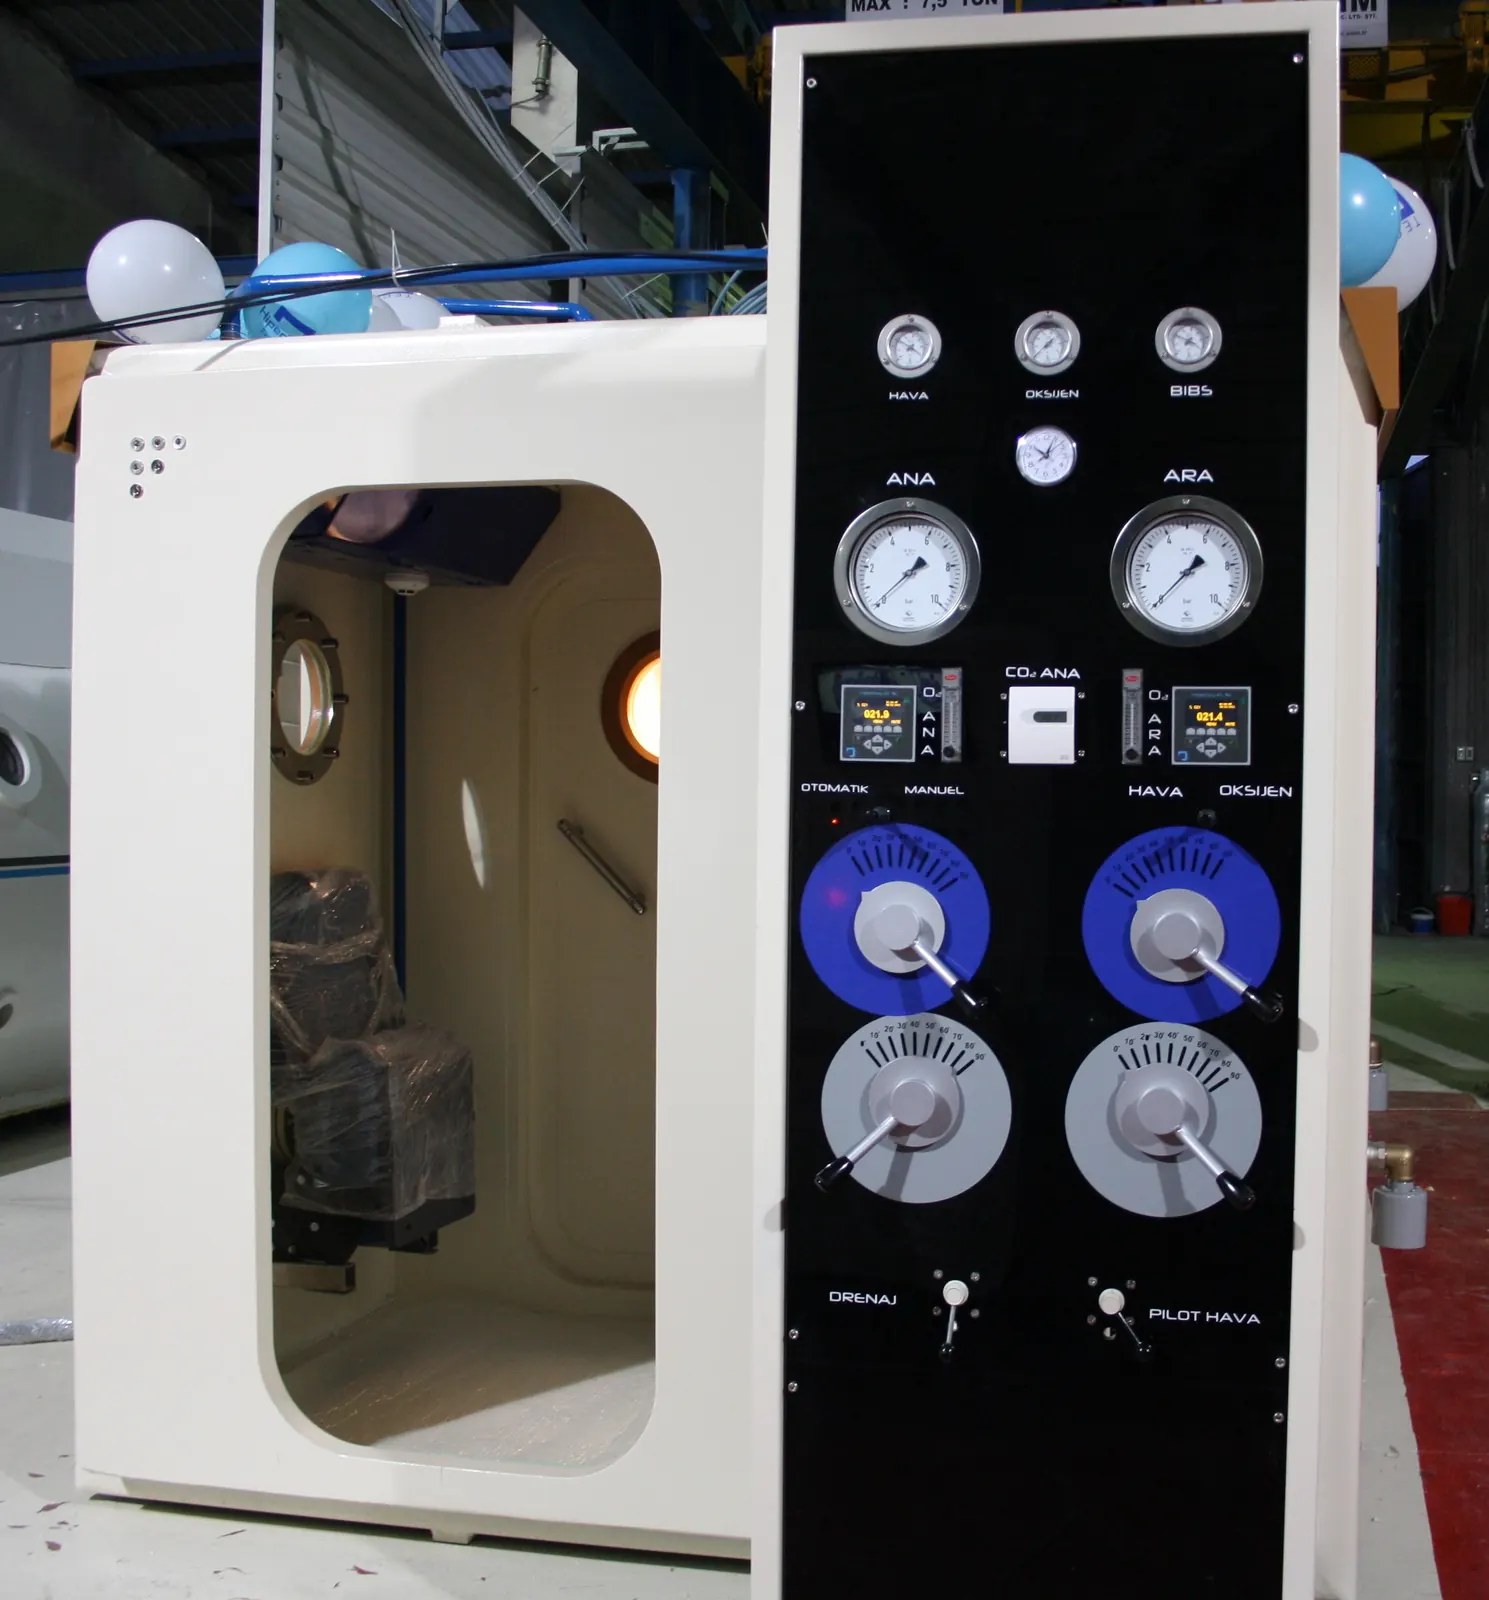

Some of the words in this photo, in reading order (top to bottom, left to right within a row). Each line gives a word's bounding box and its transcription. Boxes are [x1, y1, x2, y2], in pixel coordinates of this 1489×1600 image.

[888, 391, 929, 400] HAVA
[1025, 389, 1080, 399] OKSIJEN
[1170, 384, 1213, 397] BIBS
[886, 472, 936, 486] ANA
[1163, 468, 1215, 483] ARA
[890, 538, 895, 546] 4
[925, 537, 930, 546] 6
[1167, 536, 1172, 544] 4
[1202, 535, 1208, 544] 6
[869, 564, 874, 573] 2
[945, 563, 951, 572] 8
[1145, 563, 1150, 572] 2
[1225, 562, 1230, 571] 8
[931, 594, 939, 604] 10
[1210, 594, 1218, 603] 10
[1040, 667, 1081, 679] ANA
[863, 709, 890, 719] 021.9
[1196, 711, 1223, 722] 021.4
[800, 782, 869, 794] OTOMATIK
[904, 785, 965, 795] MANUEL
[1128, 785, 1184, 798] HAVA
[1219, 784, 1293, 798] OKSIJEN
[829, 1291, 897, 1306] DRENAJ
[1149, 1308, 1201, 1322] PILOT
[1205, 1311, 1261, 1325] HAVA
